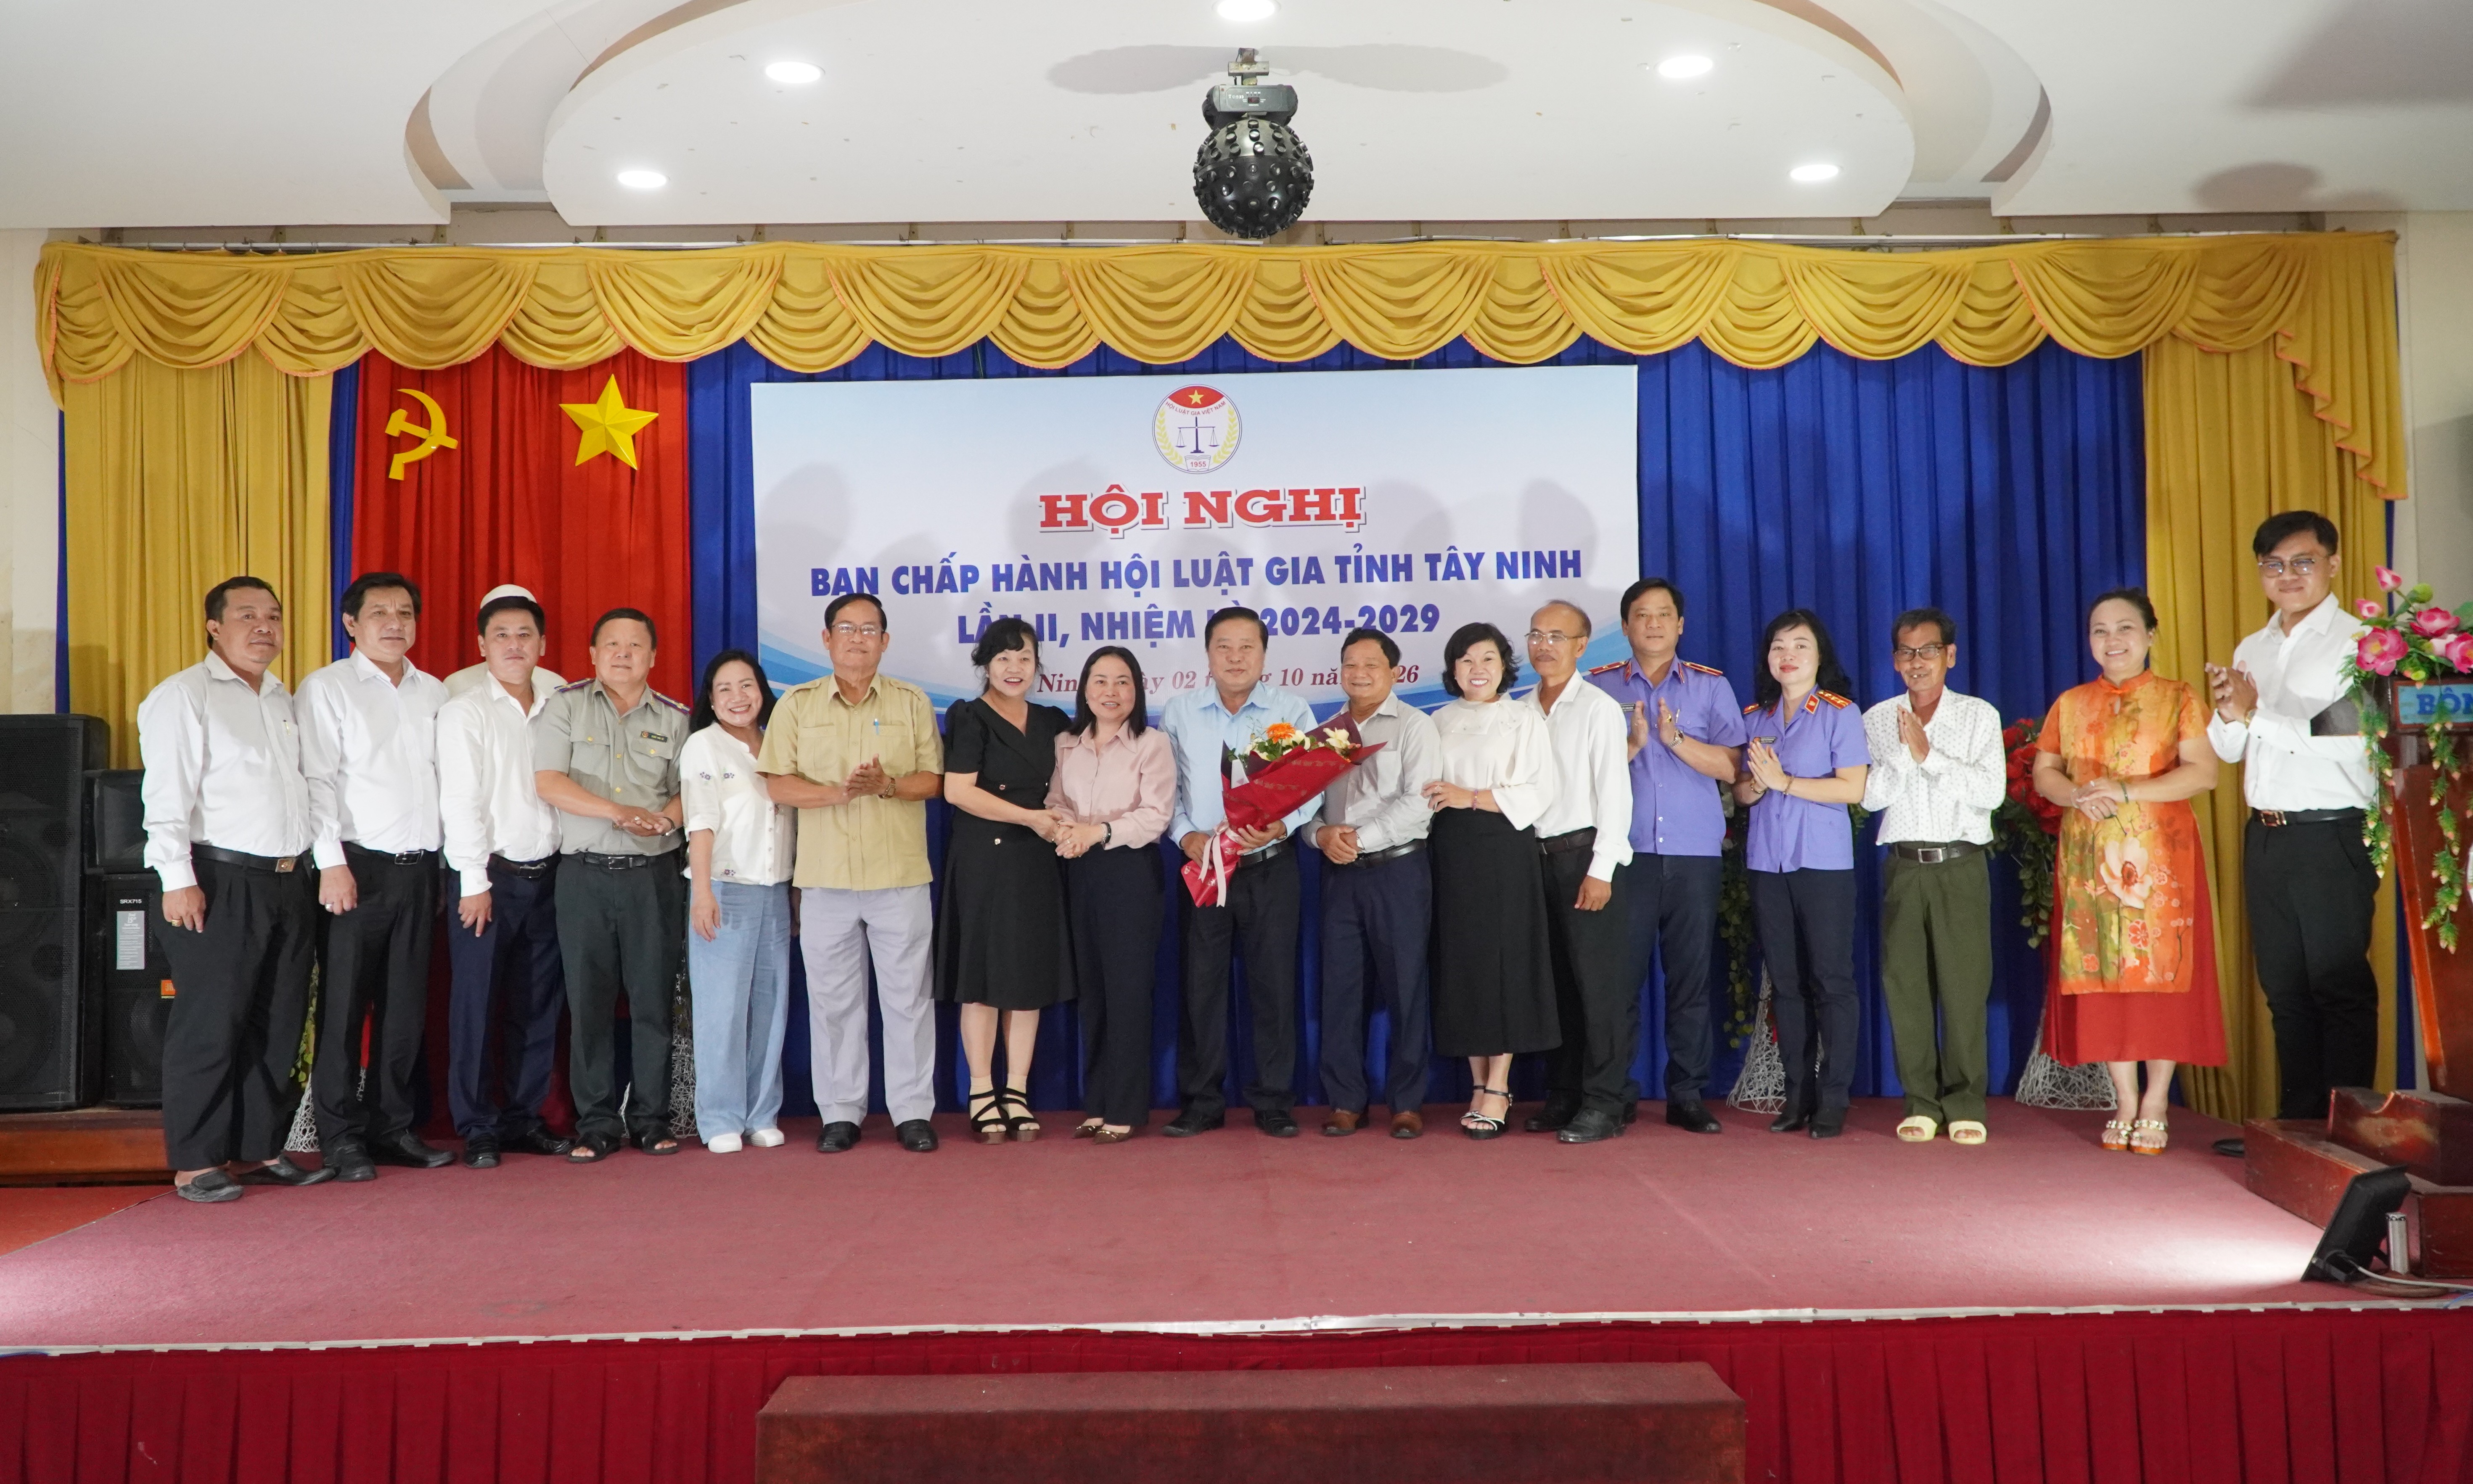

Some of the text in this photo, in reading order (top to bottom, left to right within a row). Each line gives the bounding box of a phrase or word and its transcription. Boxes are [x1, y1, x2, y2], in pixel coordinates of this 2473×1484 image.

[1214, 401, 1226, 409] NAM
[1039, 484, 1362, 534] HỘI NGHỊ
[811, 543, 1581, 597] BAN CHẤP HÀNH HỘI LUẬT GIA TỈNH TÂY NINH
[958, 602, 1021, 644] LẦ
[1081, 603, 1195, 647] NHIỆM
[1260, 604, 1440, 637] 2024-2029
[1037, 673, 1077, 693] Nin
[1172, 671, 1197, 689] 02
[1279, 668, 1304, 686] 10
[1310, 667, 1341, 686] nă
